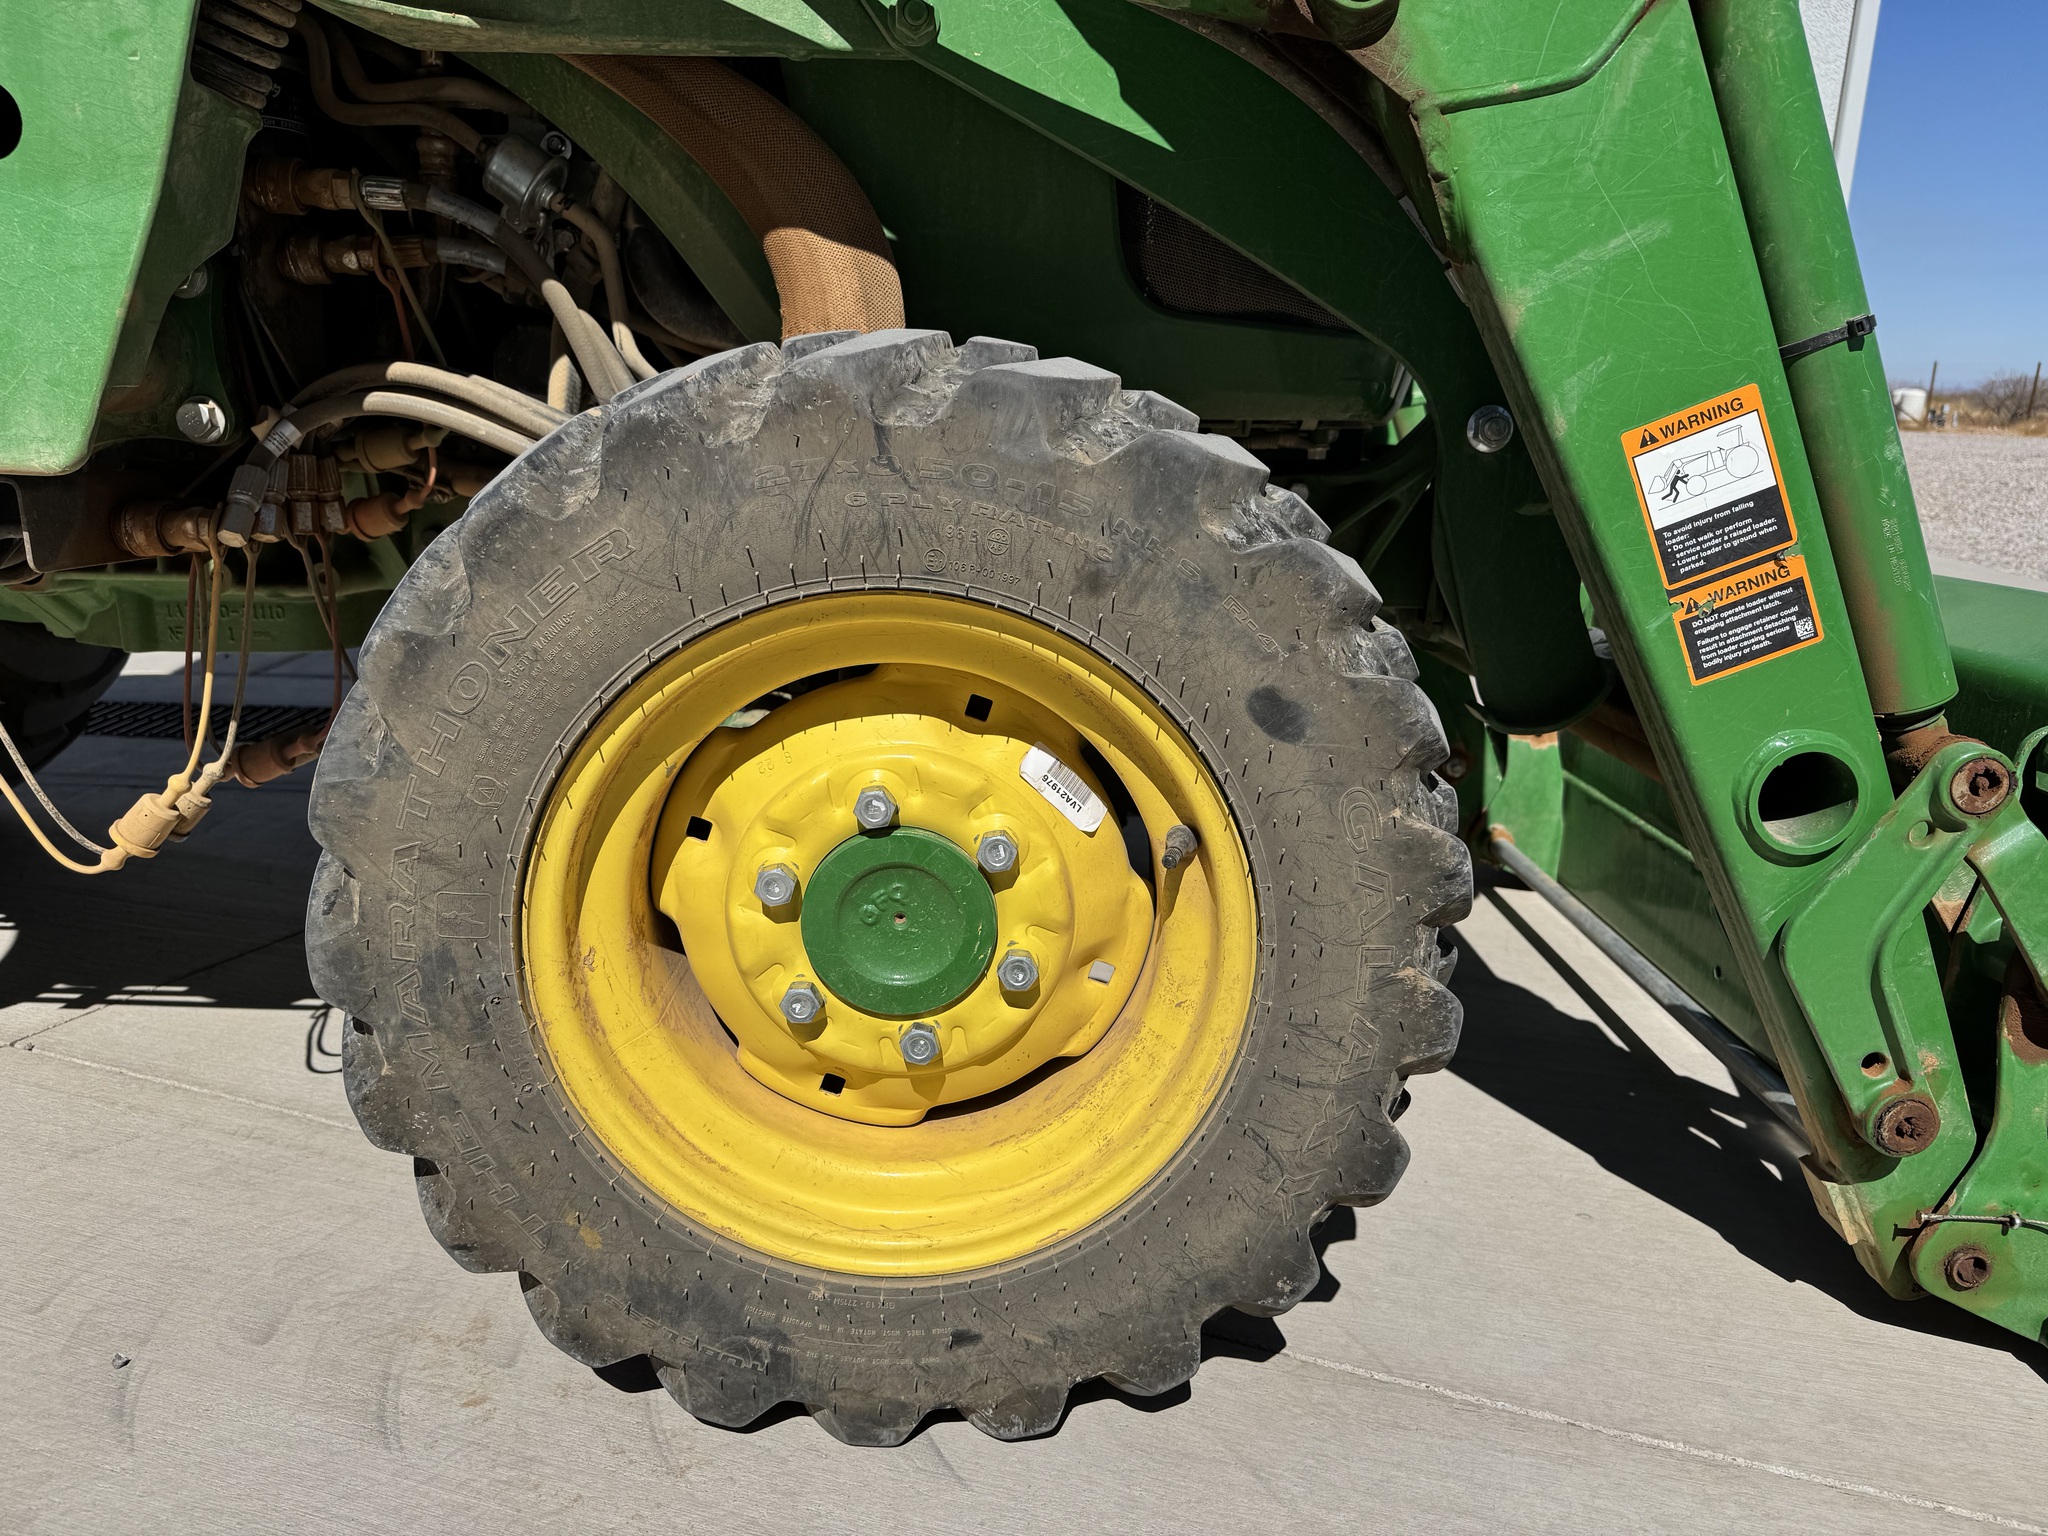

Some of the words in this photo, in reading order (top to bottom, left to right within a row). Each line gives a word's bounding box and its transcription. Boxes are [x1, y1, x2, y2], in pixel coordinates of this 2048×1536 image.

[1658, 397, 1744, 438] WARNING
[881, 493, 962, 513] PLY
[970, 501, 1115, 564] RATING
[1673, 523, 1692, 534] avoid
[1693, 515, 1713, 528] injury
[1714, 508, 1730, 519] from
[1731, 500, 1754, 514] falling
[1697, 532, 1713, 541] walk
[1724, 518, 1752, 532] perform
[1110, 516, 1207, 584] NHS
[1665, 533, 1689, 545] loader:
[1675, 545, 1700, 558] service
[1702, 537, 1722, 548] under
[1729, 526, 1751, 538] raised
[1752, 516, 1776, 529] loader.
[1677, 554, 1698, 565] Lower
[1700, 545, 1722, 557] loader
[1732, 532, 1757, 546] ground
[1758, 524, 1777, 535] when
[997, 572, 1020, 585] 1997
[1679, 559, 1706, 574] parked.
[1708, 565, 1790, 603] WARNING
[1692, 619, 1703, 627] DO
[1704, 614, 1719, 623] NOT
[1720, 605, 1745, 619] operate
[1746, 596, 1766, 608] loader
[1768, 586, 1793, 600] without
[1694, 620, 1724, 636] engaging
[1725, 606, 1762, 624] attachment
[1763, 599, 1781, 610] latch.
[1697, 634, 1719, 646] Failure
[1728, 623, 1752, 636] engage
[1753, 613, 1778, 626] retainer
[1779, 605, 1798, 616] could
[1699, 643, 1718, 654] result
[1726, 626, 1763, 644] attachment
[1764, 614, 1796, 631] detaching
[1701, 651, 1716, 661] from
[1717, 643, 1738, 655] loader
[1739, 634, 1765, 648] causing
[1765, 625, 1790, 637] serious
[1703, 657, 1723, 668] bodily
[1724, 650, 1742, 661] injury
[1751, 639, 1772, 651] death.
[501, 651, 535, 688] SAFETY
[387, 522, 639, 1096] MARATHONER
[1041, 774, 1082, 812] LVA21976
[1272, 782, 1395, 1225] GALAXY
[441, 1107, 547, 1252] THE
